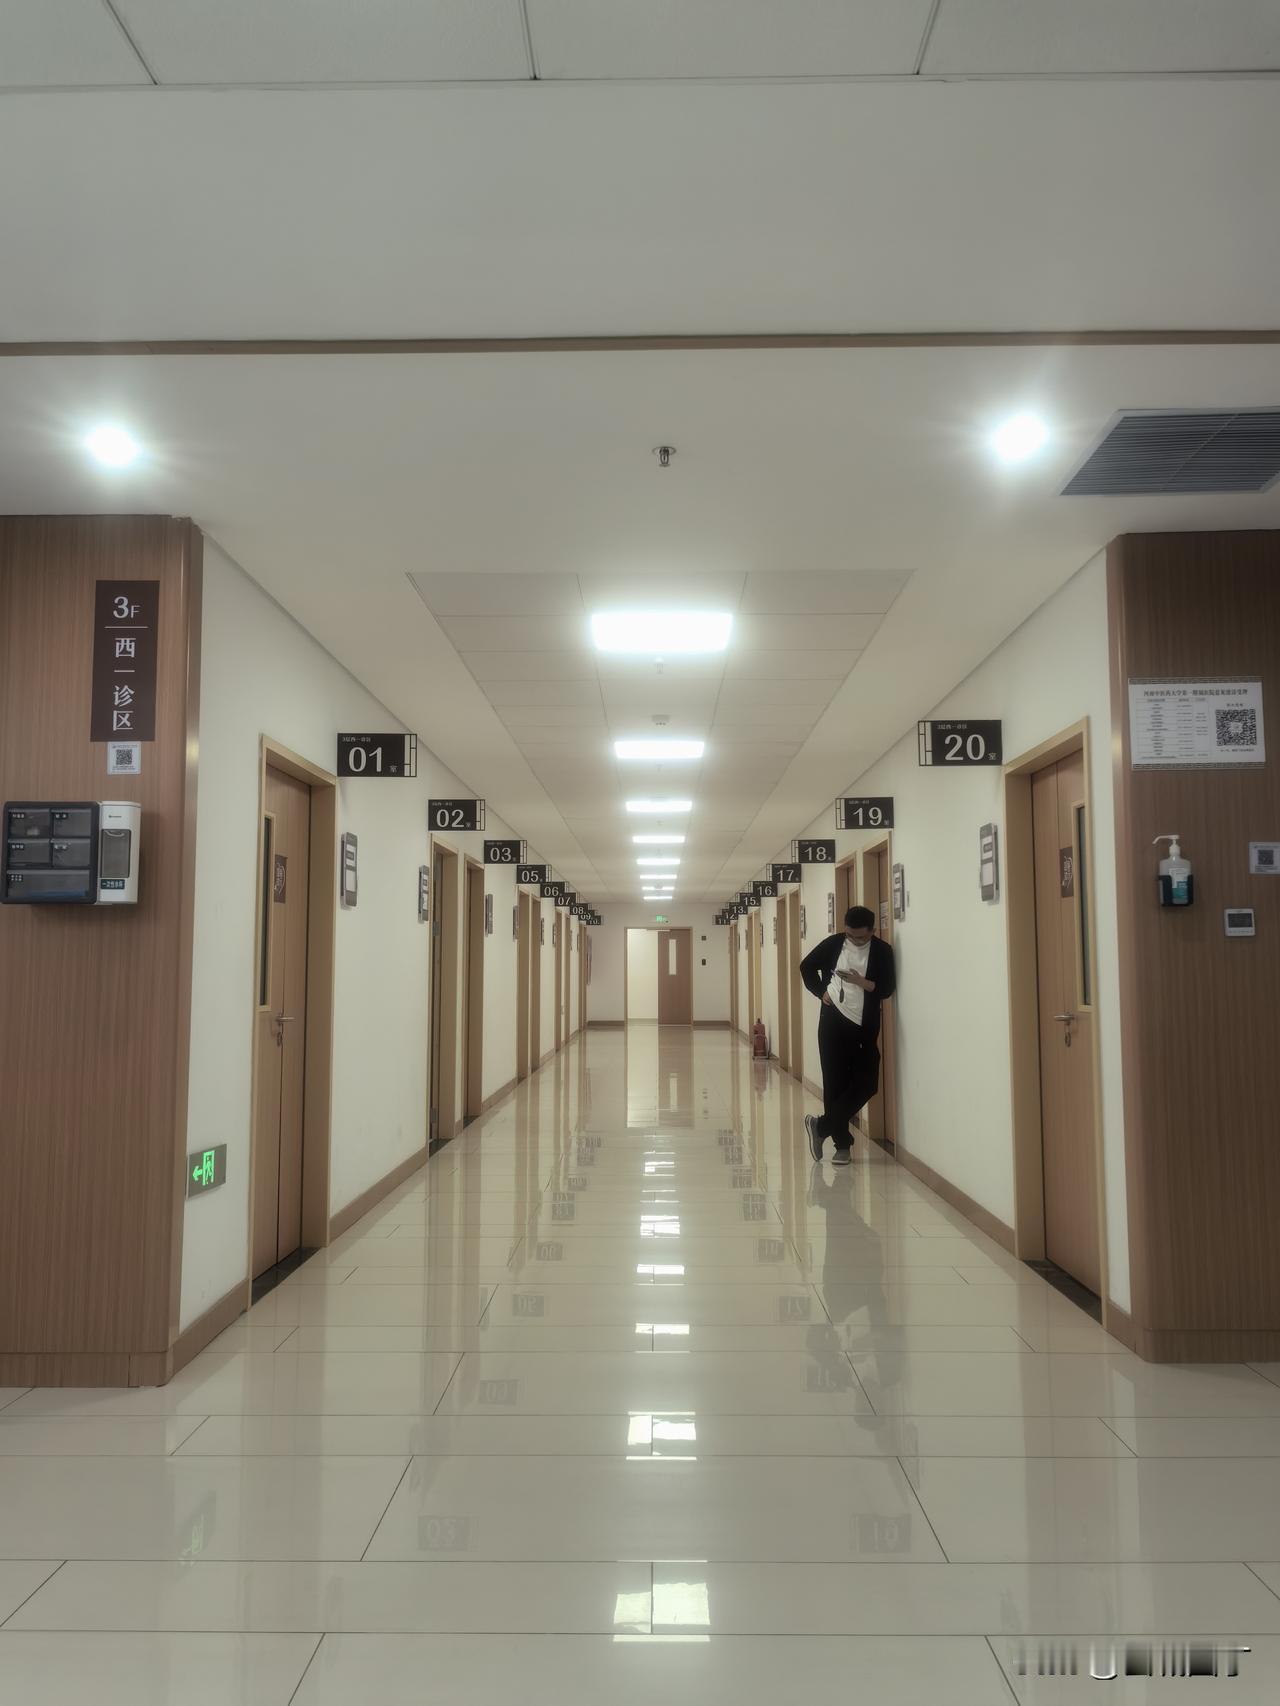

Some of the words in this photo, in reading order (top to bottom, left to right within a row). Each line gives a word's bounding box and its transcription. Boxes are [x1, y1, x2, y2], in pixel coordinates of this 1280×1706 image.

[112, 595, 141, 619] 3F
[112, 637, 137, 731] 西一诊区
[944, 733, 986, 761] 20
[348, 746, 383, 773] 01
[436, 808, 465, 828] 02
[852, 806, 883, 826] 19
[490, 847, 512, 862] 03
[804, 846, 827, 861] 18
[521, 870, 539, 883] 05
[776, 869, 795, 881] 17
[544, 886, 559, 897] 06
[757, 885, 773, 896] 16
[743, 896, 756, 906] 15
[572, 906, 584, 915] 08
[732, 905, 744, 914] 13
